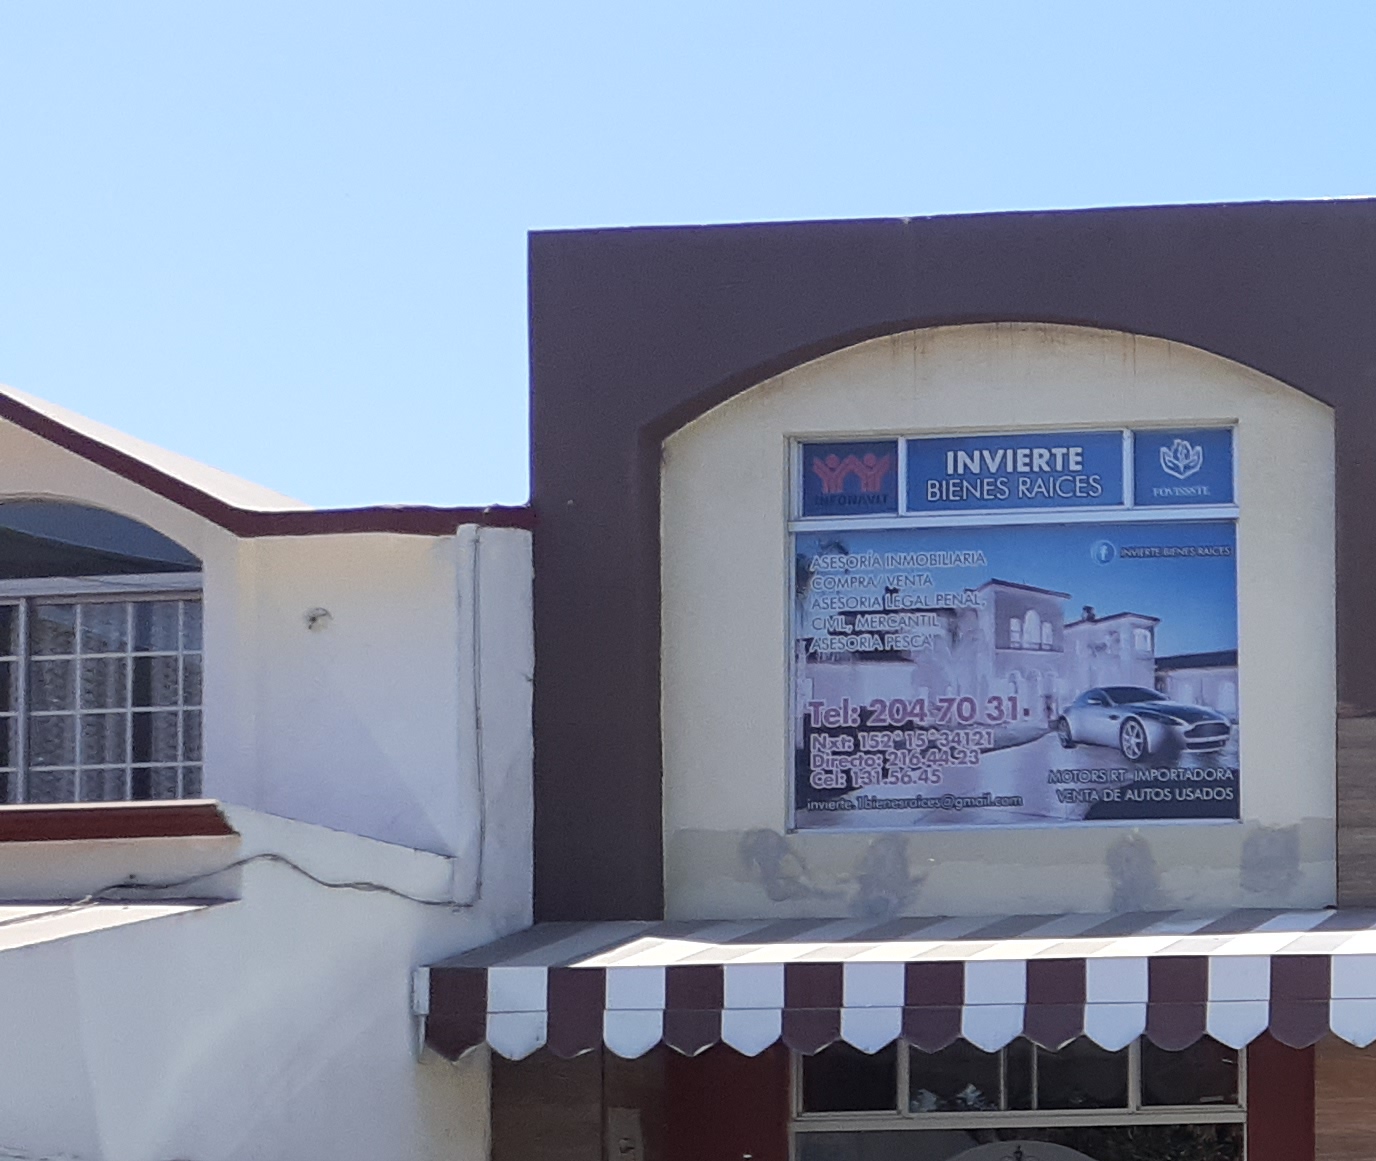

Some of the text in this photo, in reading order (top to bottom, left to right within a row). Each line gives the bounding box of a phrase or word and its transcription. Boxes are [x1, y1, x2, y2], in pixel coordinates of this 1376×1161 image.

[946, 447, 1083, 475] INVIERTE
[926, 475, 1103, 501] BIENES RAICES
[886, 551, 986, 568] INMOBILIARIA
[887, 574, 933, 588] VENTA
[887, 595, 930, 607] LEGAL
[857, 615, 940, 629] MERCANTIL
[809, 699, 860, 725] Tel:
[869, 699, 927, 724] 204
[937, 699, 977, 722] 70
[812, 751, 979, 768] Directo: 216.44.23
[811, 770, 941, 787] Cel: 131.56.45
[1050, 770, 1105, 783] MOTORS
[1135, 769, 1233, 781] IMPORTADORA
[1057, 788, 1233, 802] VENTA DE AUTOS USADOS
